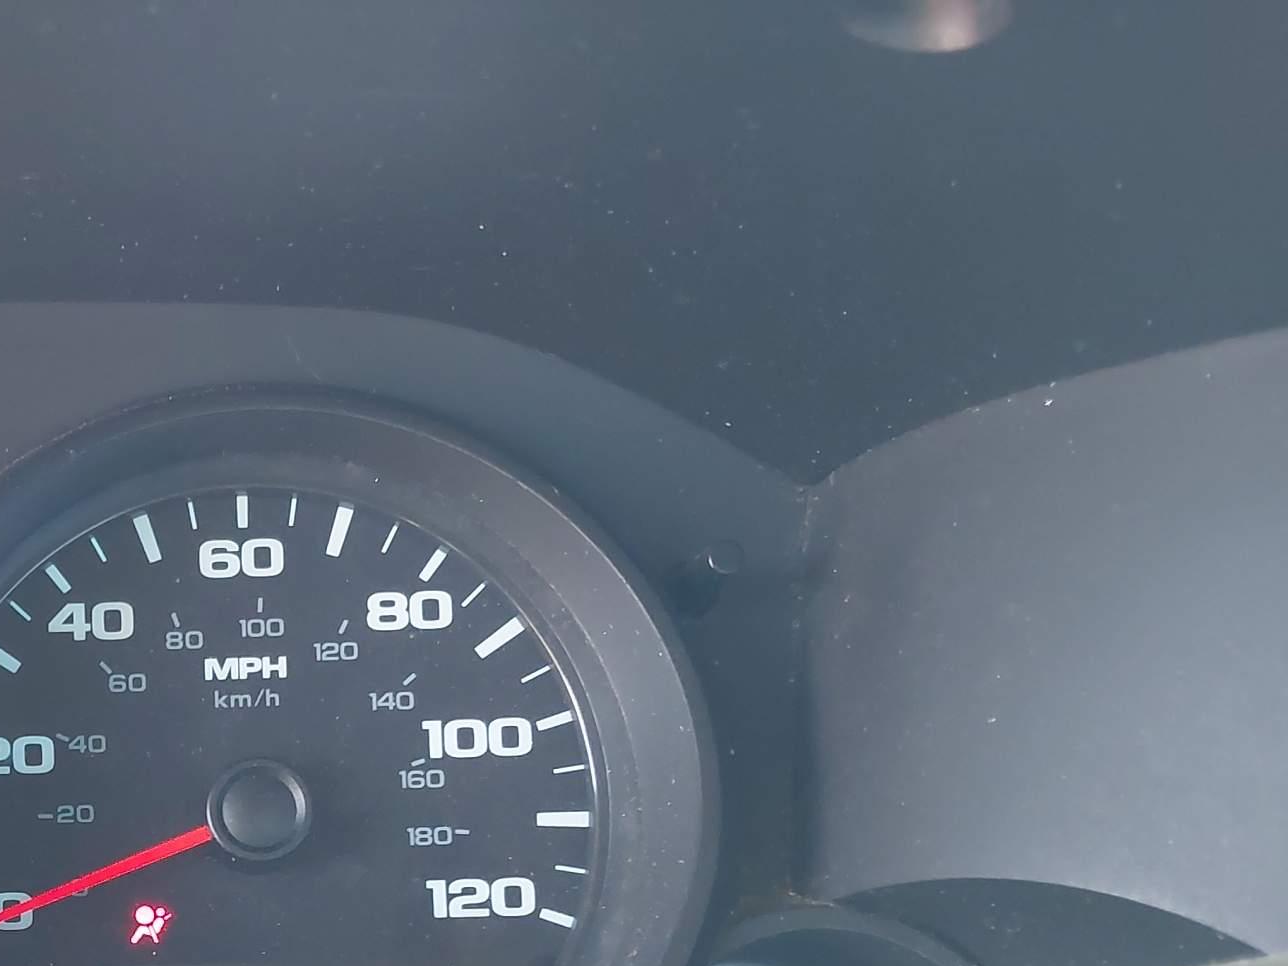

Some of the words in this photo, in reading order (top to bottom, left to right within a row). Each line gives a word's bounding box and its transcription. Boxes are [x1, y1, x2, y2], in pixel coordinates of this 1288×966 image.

[198, 538, 285, 579] 60
[365, 590, 452, 631] 80
[48, 602, 135, 641] 40
[239, 617, 285, 638] 100
[165, 629, 204, 651] 80
[313, 641, 359, 662] 120
[203, 656, 287, 681] MPH
[108, 672, 147, 693] 60
[213, 688, 280, 709] km/h
[369, 691, 415, 711] 140
[68, 733, 106, 754] 40
[421, 717, 534, 758] 100
[398, 768, 445, 790] 160
[56, 804, 95, 824] 20
[407, 826, 453, 847] 180
[426, 877, 535, 918] 120
